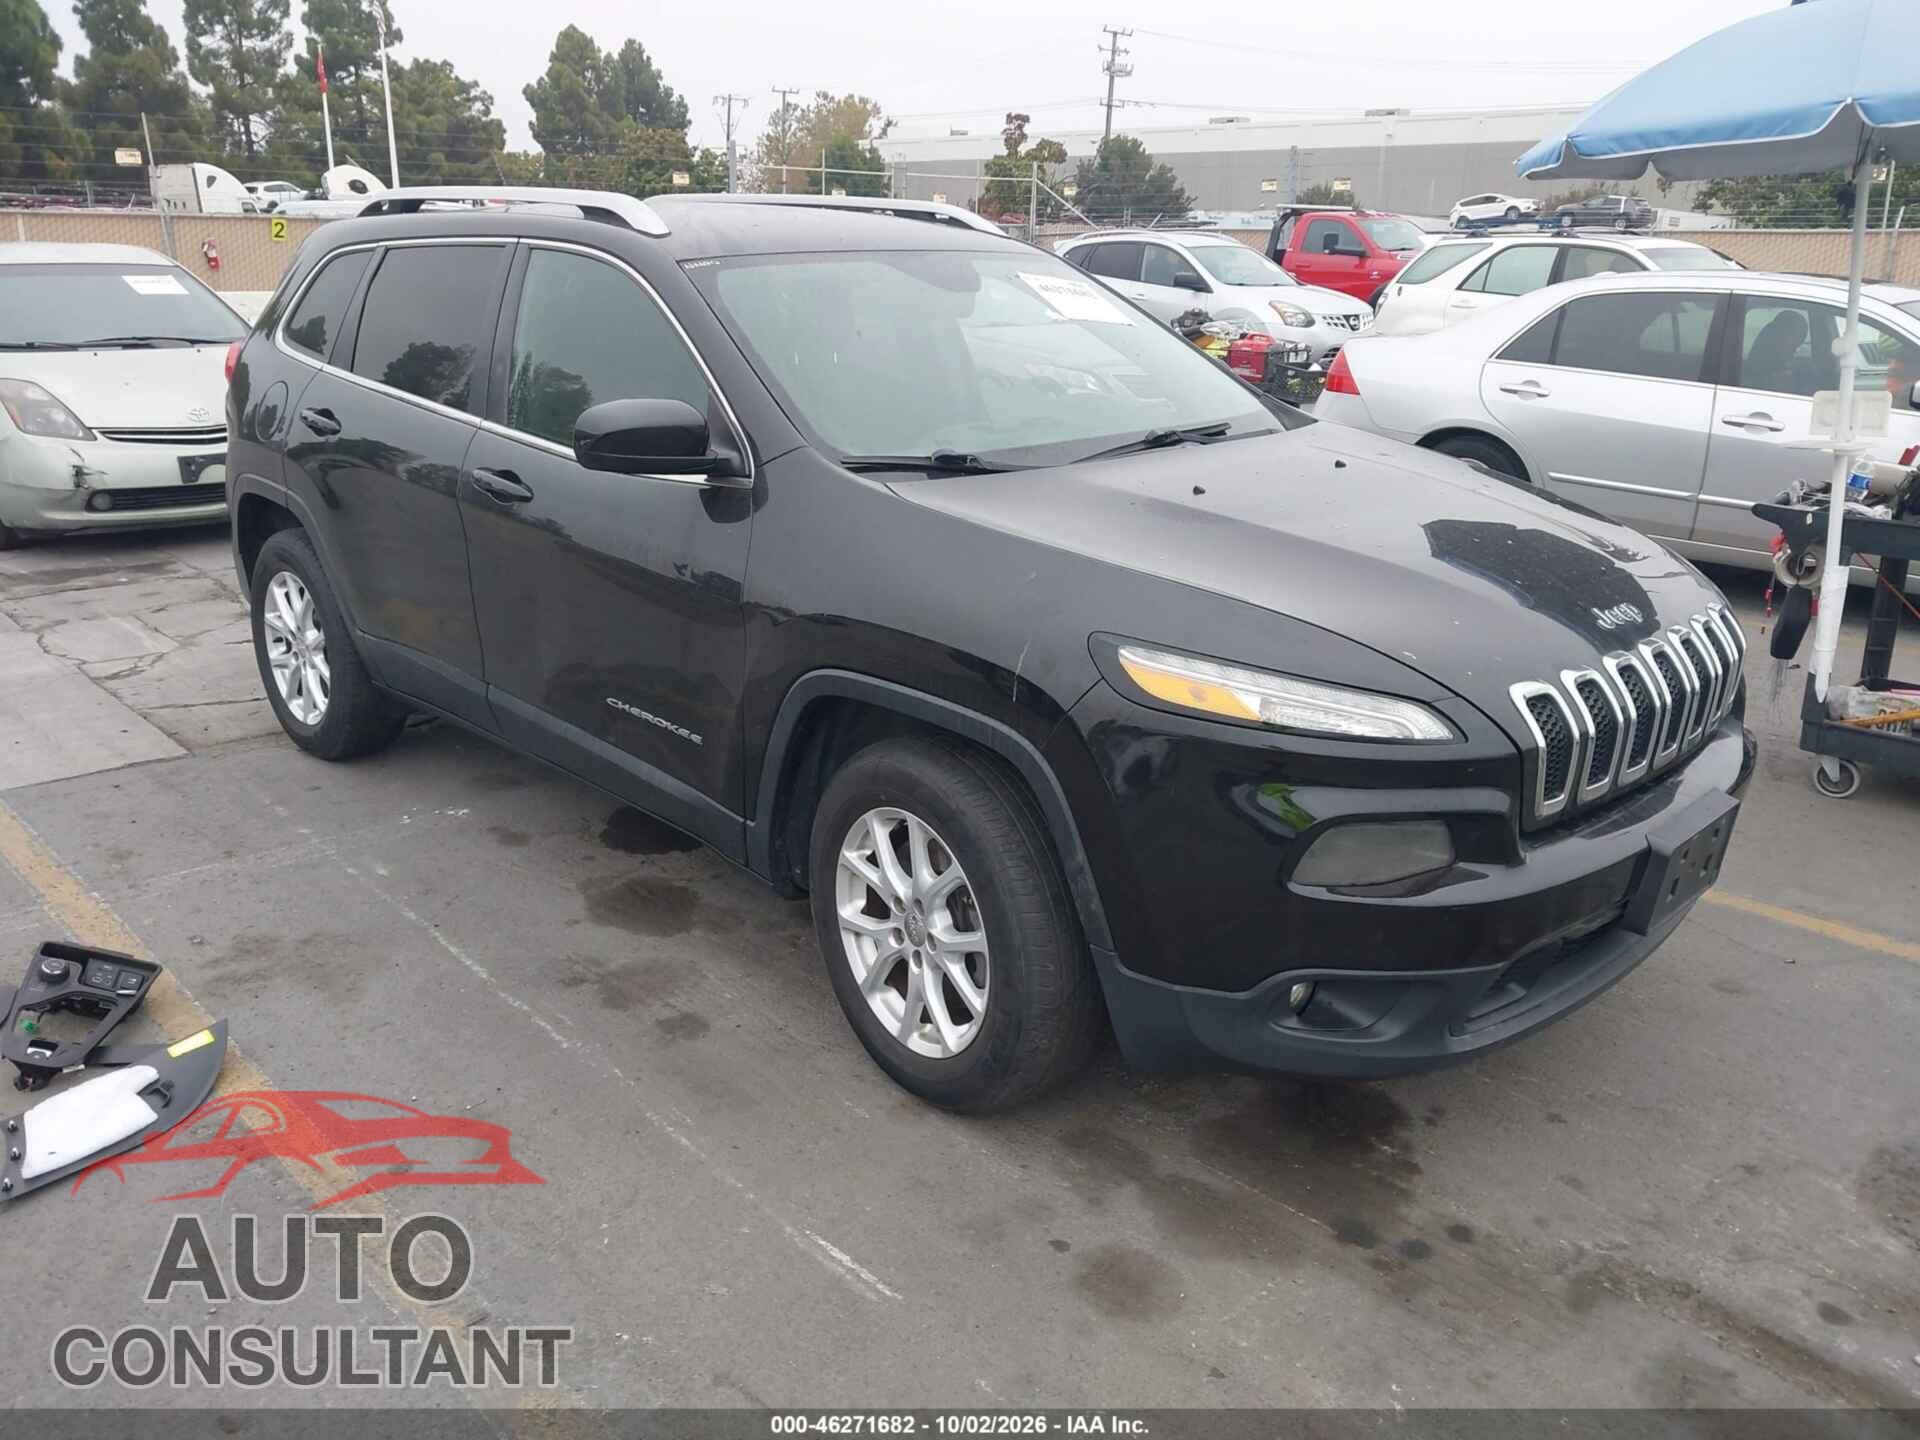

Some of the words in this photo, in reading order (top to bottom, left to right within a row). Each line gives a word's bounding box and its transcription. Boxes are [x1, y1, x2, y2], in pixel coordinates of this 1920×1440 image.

[274, 221, 285, 239] 2
[1592, 602, 1644, 630] Jeep
[605, 697, 704, 746] CHEROKEE
